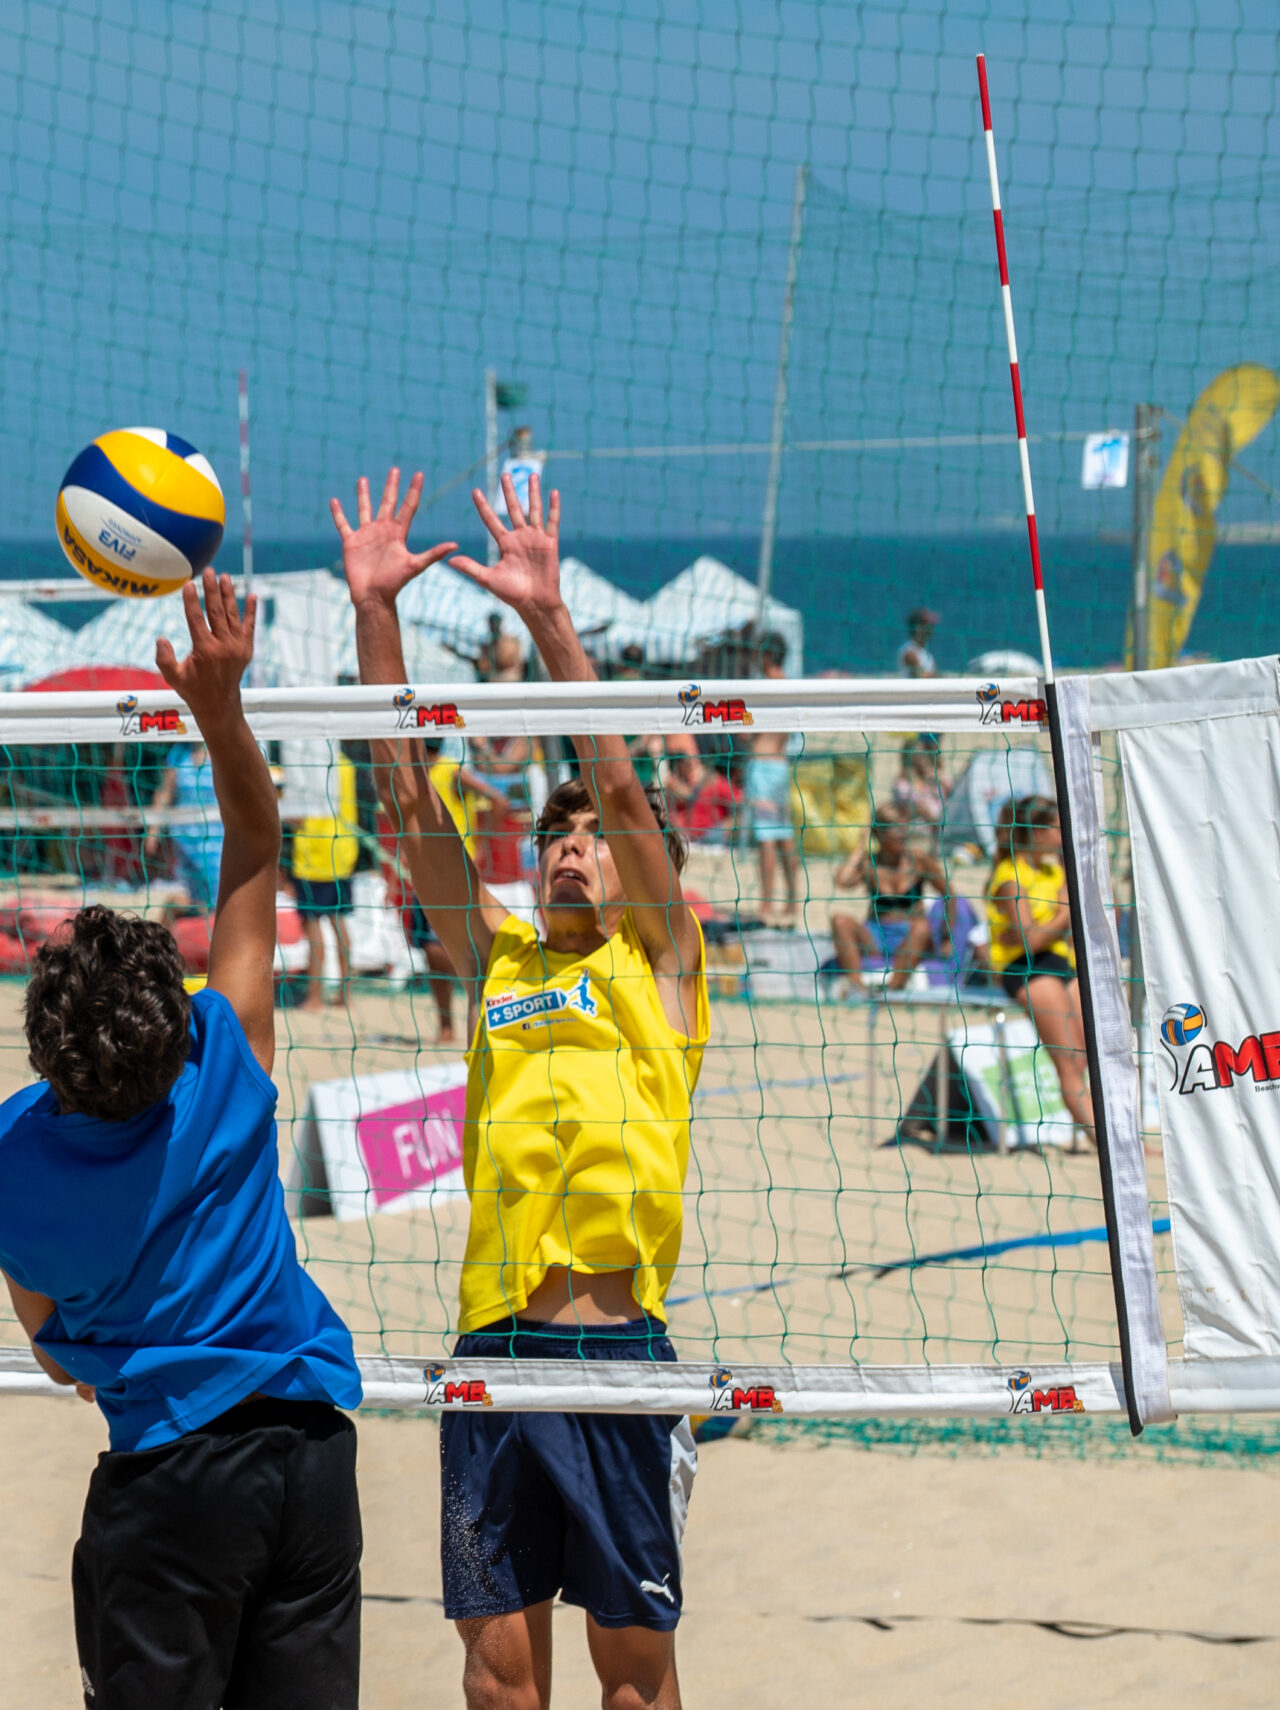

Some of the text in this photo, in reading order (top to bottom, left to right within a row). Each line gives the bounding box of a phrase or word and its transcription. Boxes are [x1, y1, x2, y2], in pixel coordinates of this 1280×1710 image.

[98, 528, 136, 562] FIVB
[64, 524, 160, 595] MIKASA
[399, 703, 458, 729] AMB
[685, 699, 746, 726] AMB
[393, 1109, 461, 1180] FUN
[427, 1380, 486, 1405] AMB
[714, 1385, 775, 1411] AMB
[1013, 1386, 1077, 1414] AMB
